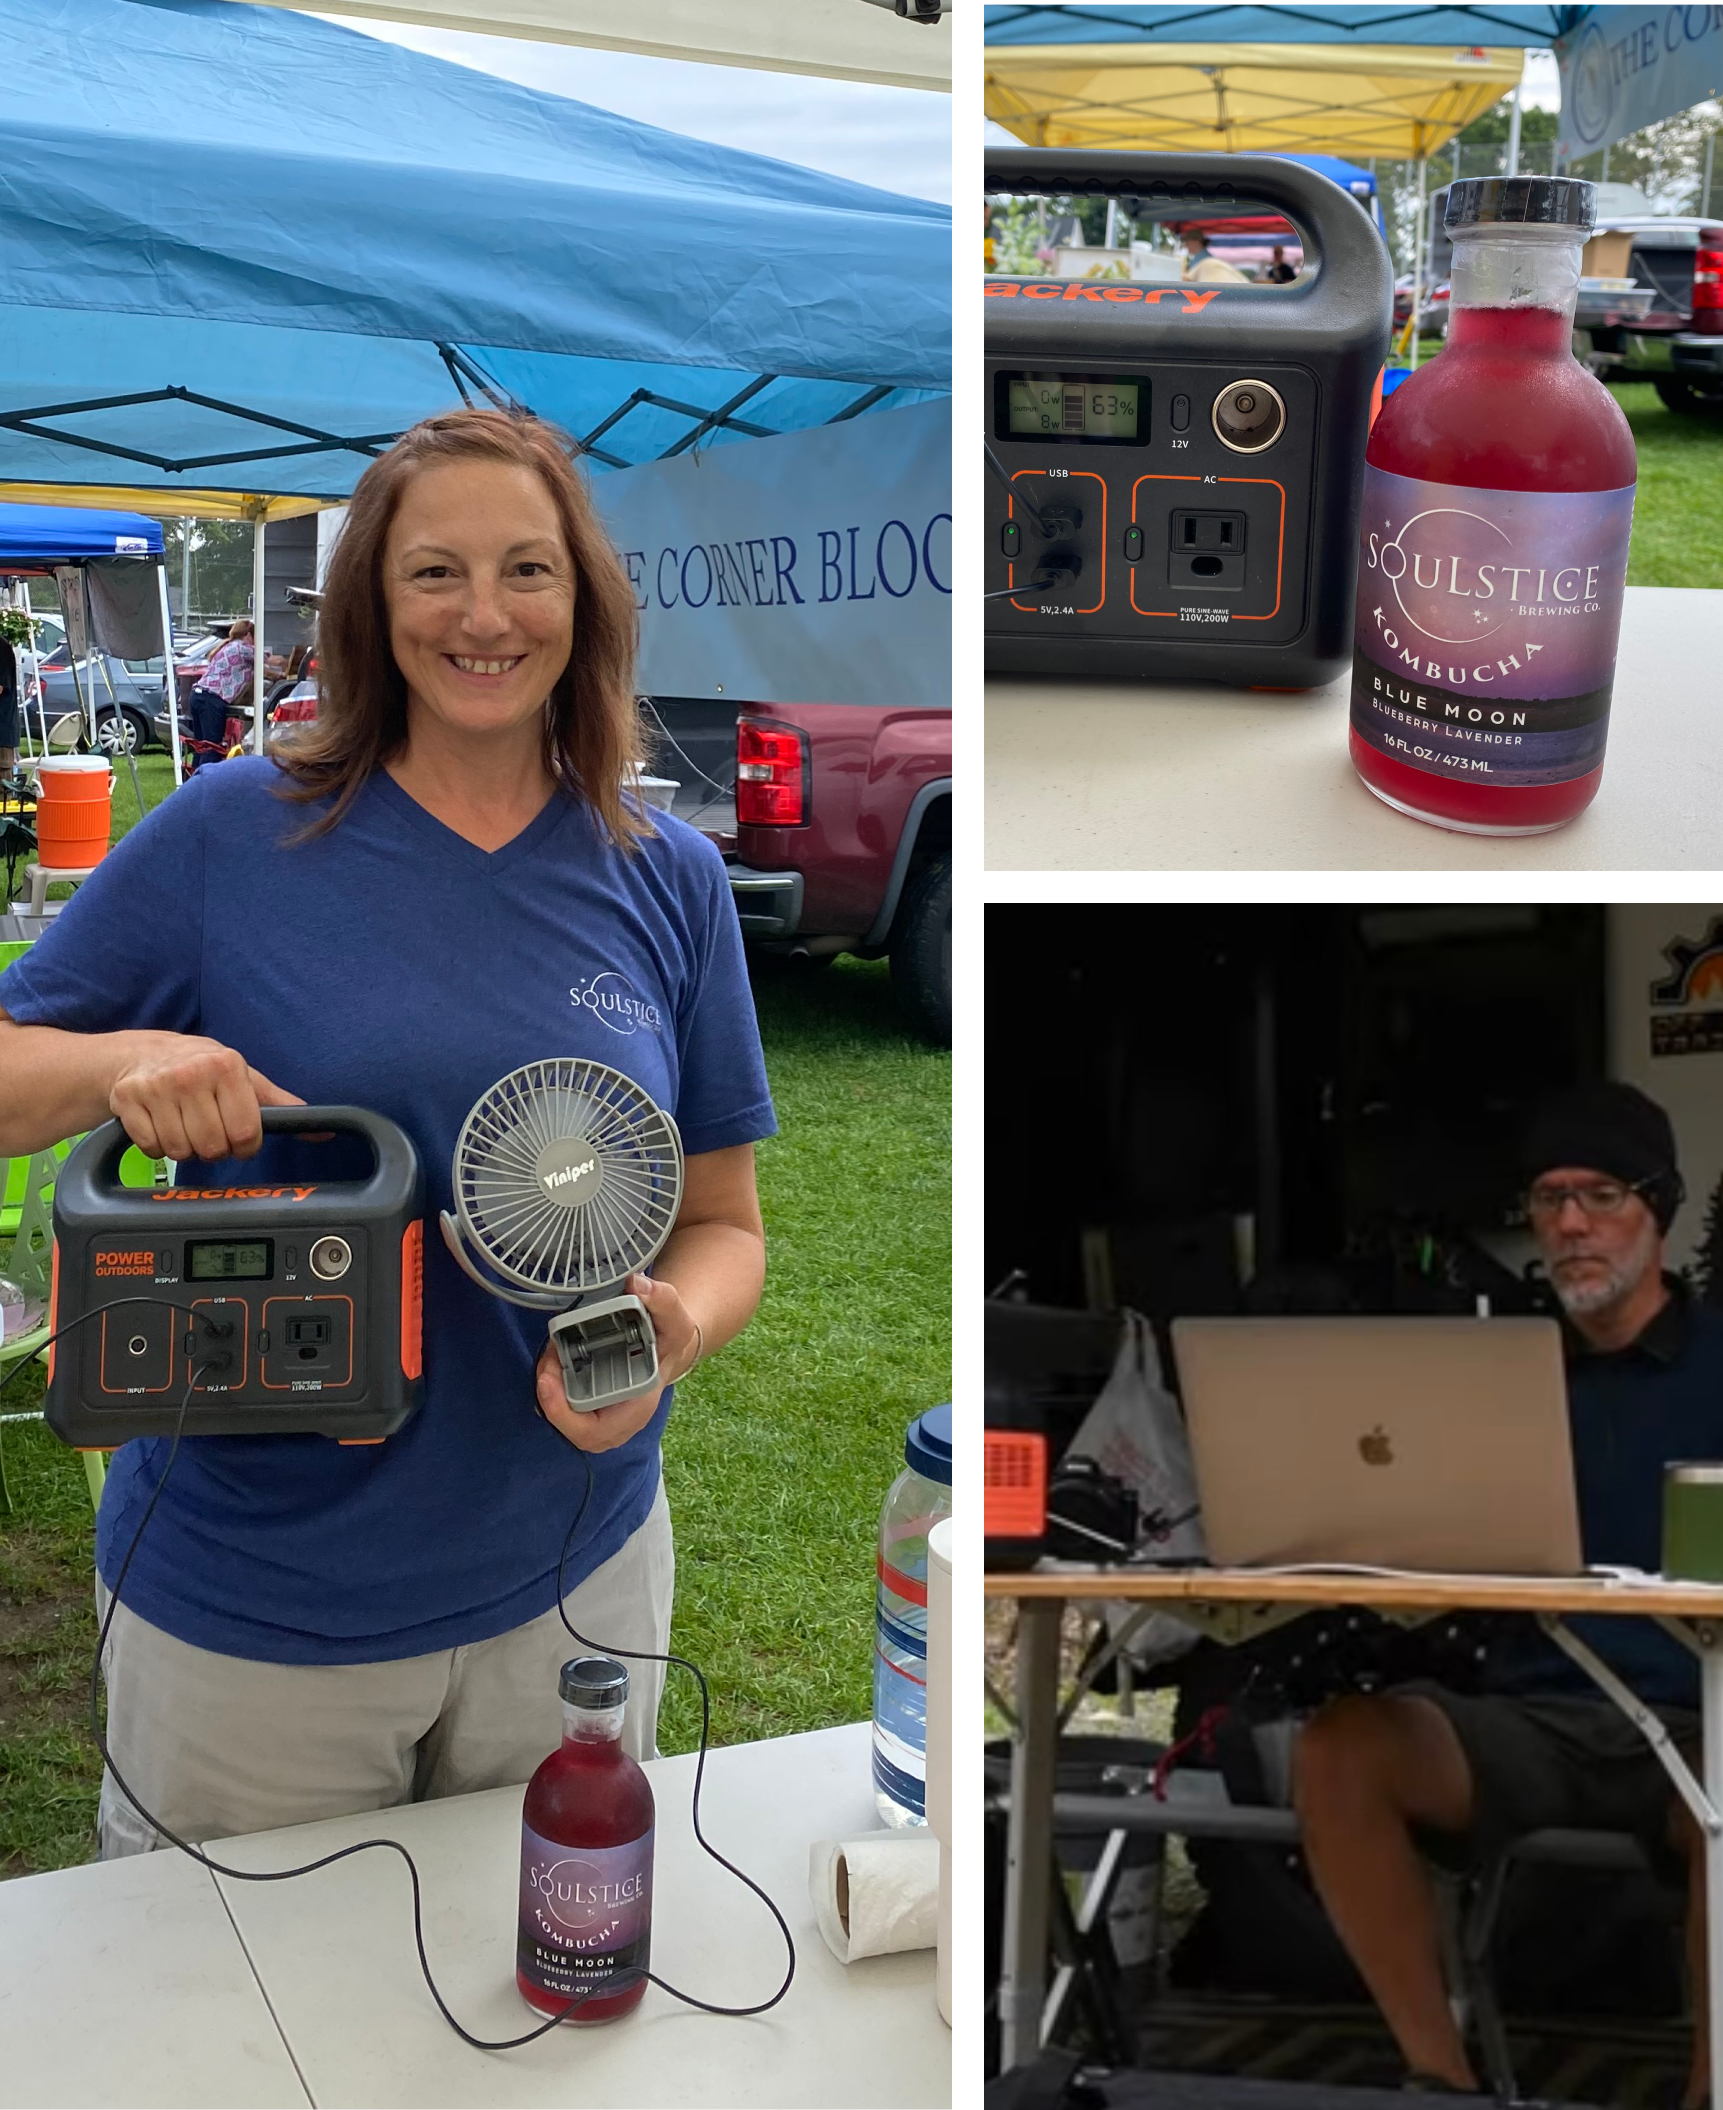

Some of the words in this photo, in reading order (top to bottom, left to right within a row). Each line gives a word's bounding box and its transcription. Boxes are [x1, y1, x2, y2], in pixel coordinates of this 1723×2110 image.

[1611, 20, 1659, 86] THE
[1664, 5, 1723, 52] CO
[1093, 395, 1134, 416] 63%
[1171, 440, 1189, 449] 12V
[1049, 469, 1069, 478] USB
[1203, 475, 1217, 484] AC
[657, 536, 805, 609] CORNER
[1367, 533, 1600, 603] SOULSTICE
[1040, 605, 1074, 616] 5V,2.4A
[1180, 613, 1229, 623] 110V,200W
[1373, 604, 1545, 684] KOMBUCHA
[1373, 676, 1427, 711] BLUE
[1445, 703, 1526, 726] MOON
[1372, 697, 1438, 733] BLUEBERRY
[1445, 725, 1523, 745] LAVENDER
[1384, 732, 1395, 747] 16
[1396, 738, 1411, 754] FL
[1413, 745, 1433, 761] OZ
[1442, 754, 1469, 769] 473
[1471, 761, 1494, 773] ML
[543, 1158, 595, 1190] Viniper
[152, 1186, 318, 1202] Jackery
[95, 1252, 154, 1266] POWER
[95, 1265, 154, 1277] OUTDOORS
[530, 1866, 642, 1904] SOULSTICE
[535, 1909, 620, 1949] KOMBUCHA
[536, 1947, 567, 1965] BLUE
[575, 1957, 615, 1968] MOON
[536, 1959, 573, 1977] BLUEBERRY
[576, 1969, 613, 1978] LAVENDER
